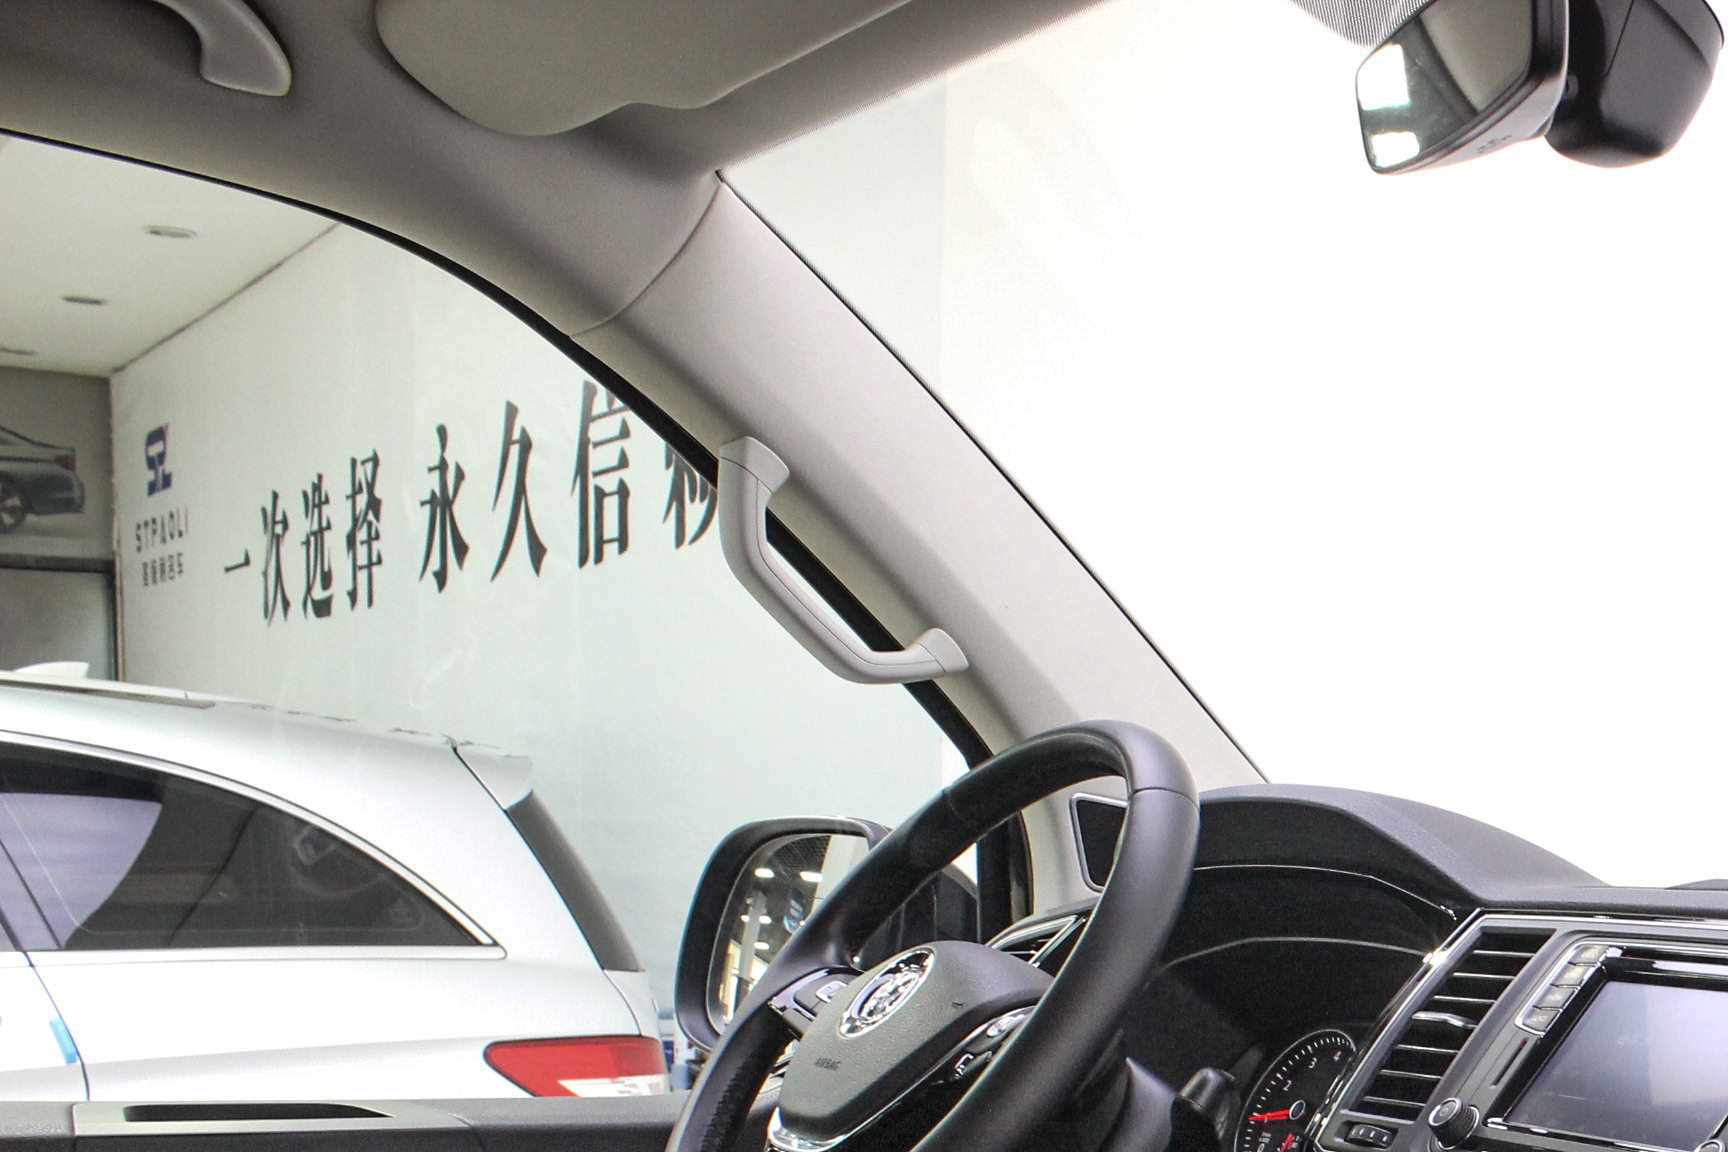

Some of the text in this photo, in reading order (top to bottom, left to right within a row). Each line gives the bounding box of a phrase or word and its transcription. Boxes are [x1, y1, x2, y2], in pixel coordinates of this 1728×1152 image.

[224, 448, 384, 628] 一次选择
[1332, 1051, 1342, 1062] 4
[1308, 1058, 1318, 1069] 3
[1283, 1080, 1292, 1092] 2
